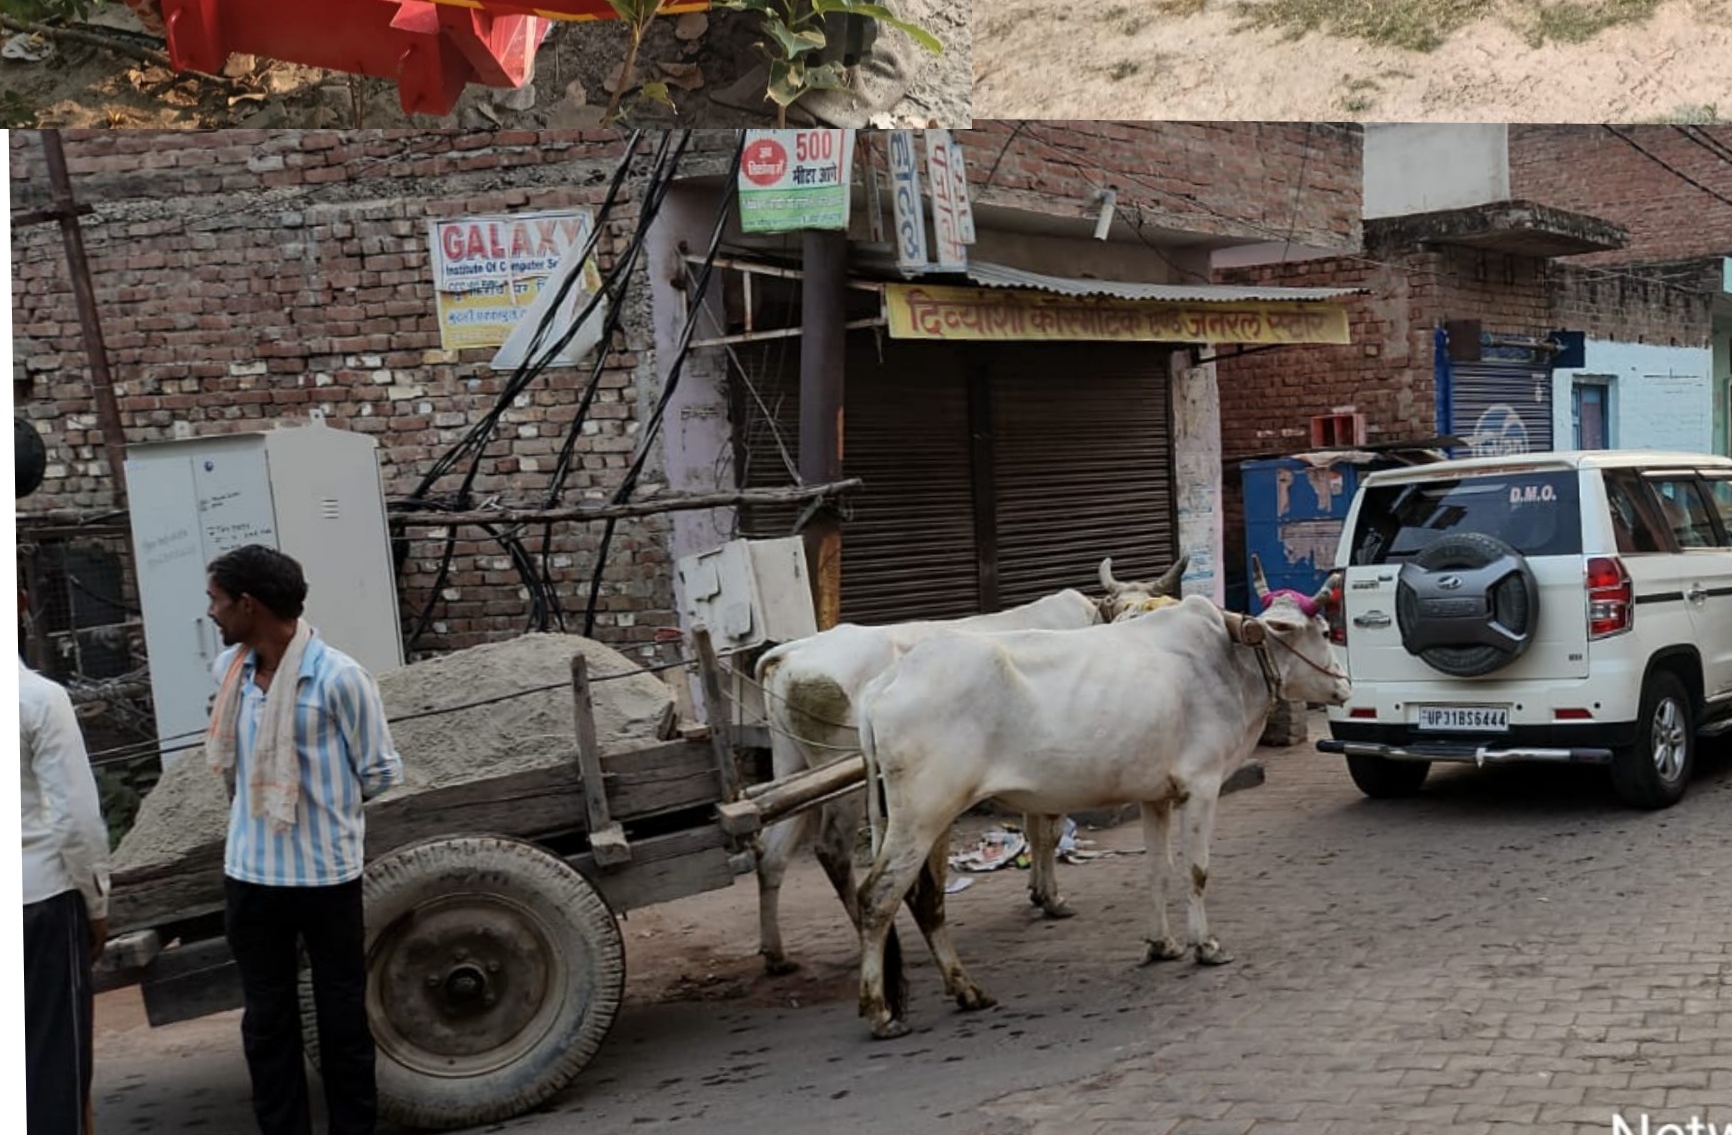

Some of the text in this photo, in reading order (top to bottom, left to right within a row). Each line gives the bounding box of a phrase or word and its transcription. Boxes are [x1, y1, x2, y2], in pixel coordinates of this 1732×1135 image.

[796, 131, 832, 162] 500
[792, 165, 817, 185] मीटर
[818, 162, 838, 182] आगे
[446, 263, 483, 276] Institute
[485, 262, 497, 275] Of
[499, 259, 545, 274] Cmputer
[1181, 309, 1262, 339] जनरल
[1509, 485, 1557, 503] D.M.O.
[1428, 710, 1506, 728] UP31BS6444
